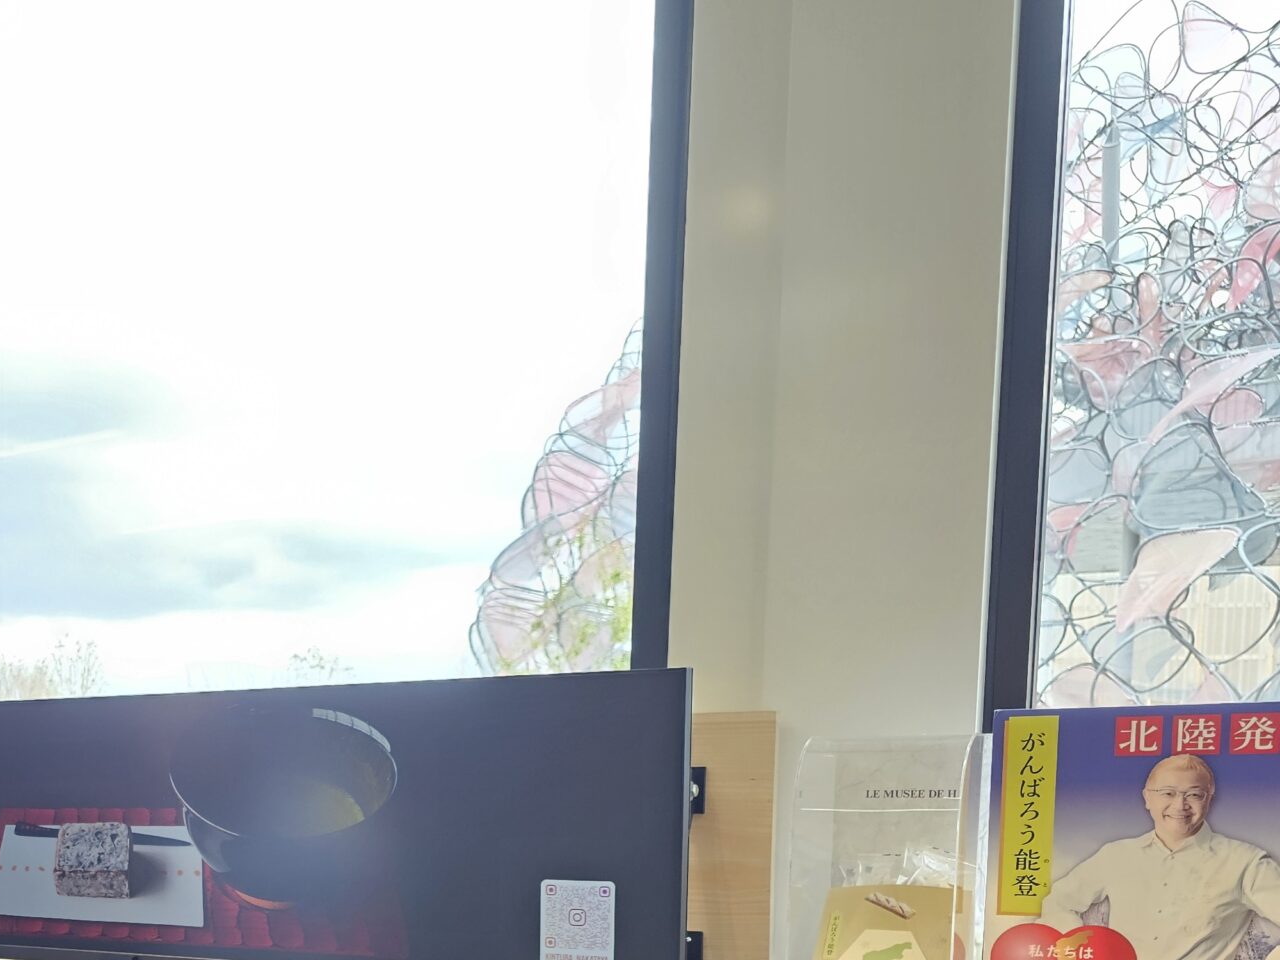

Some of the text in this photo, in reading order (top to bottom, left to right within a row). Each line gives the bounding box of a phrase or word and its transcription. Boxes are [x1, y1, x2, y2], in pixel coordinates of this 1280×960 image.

[1119, 716, 1277, 752] 北陸発
[865, 789, 881, 799] LE
[928, 789, 945, 799] DE
[947, 789, 958, 798] H
[1012, 732, 1046, 897] がんばろう能登
[1028, 944, 1094, 960] 私たちは
